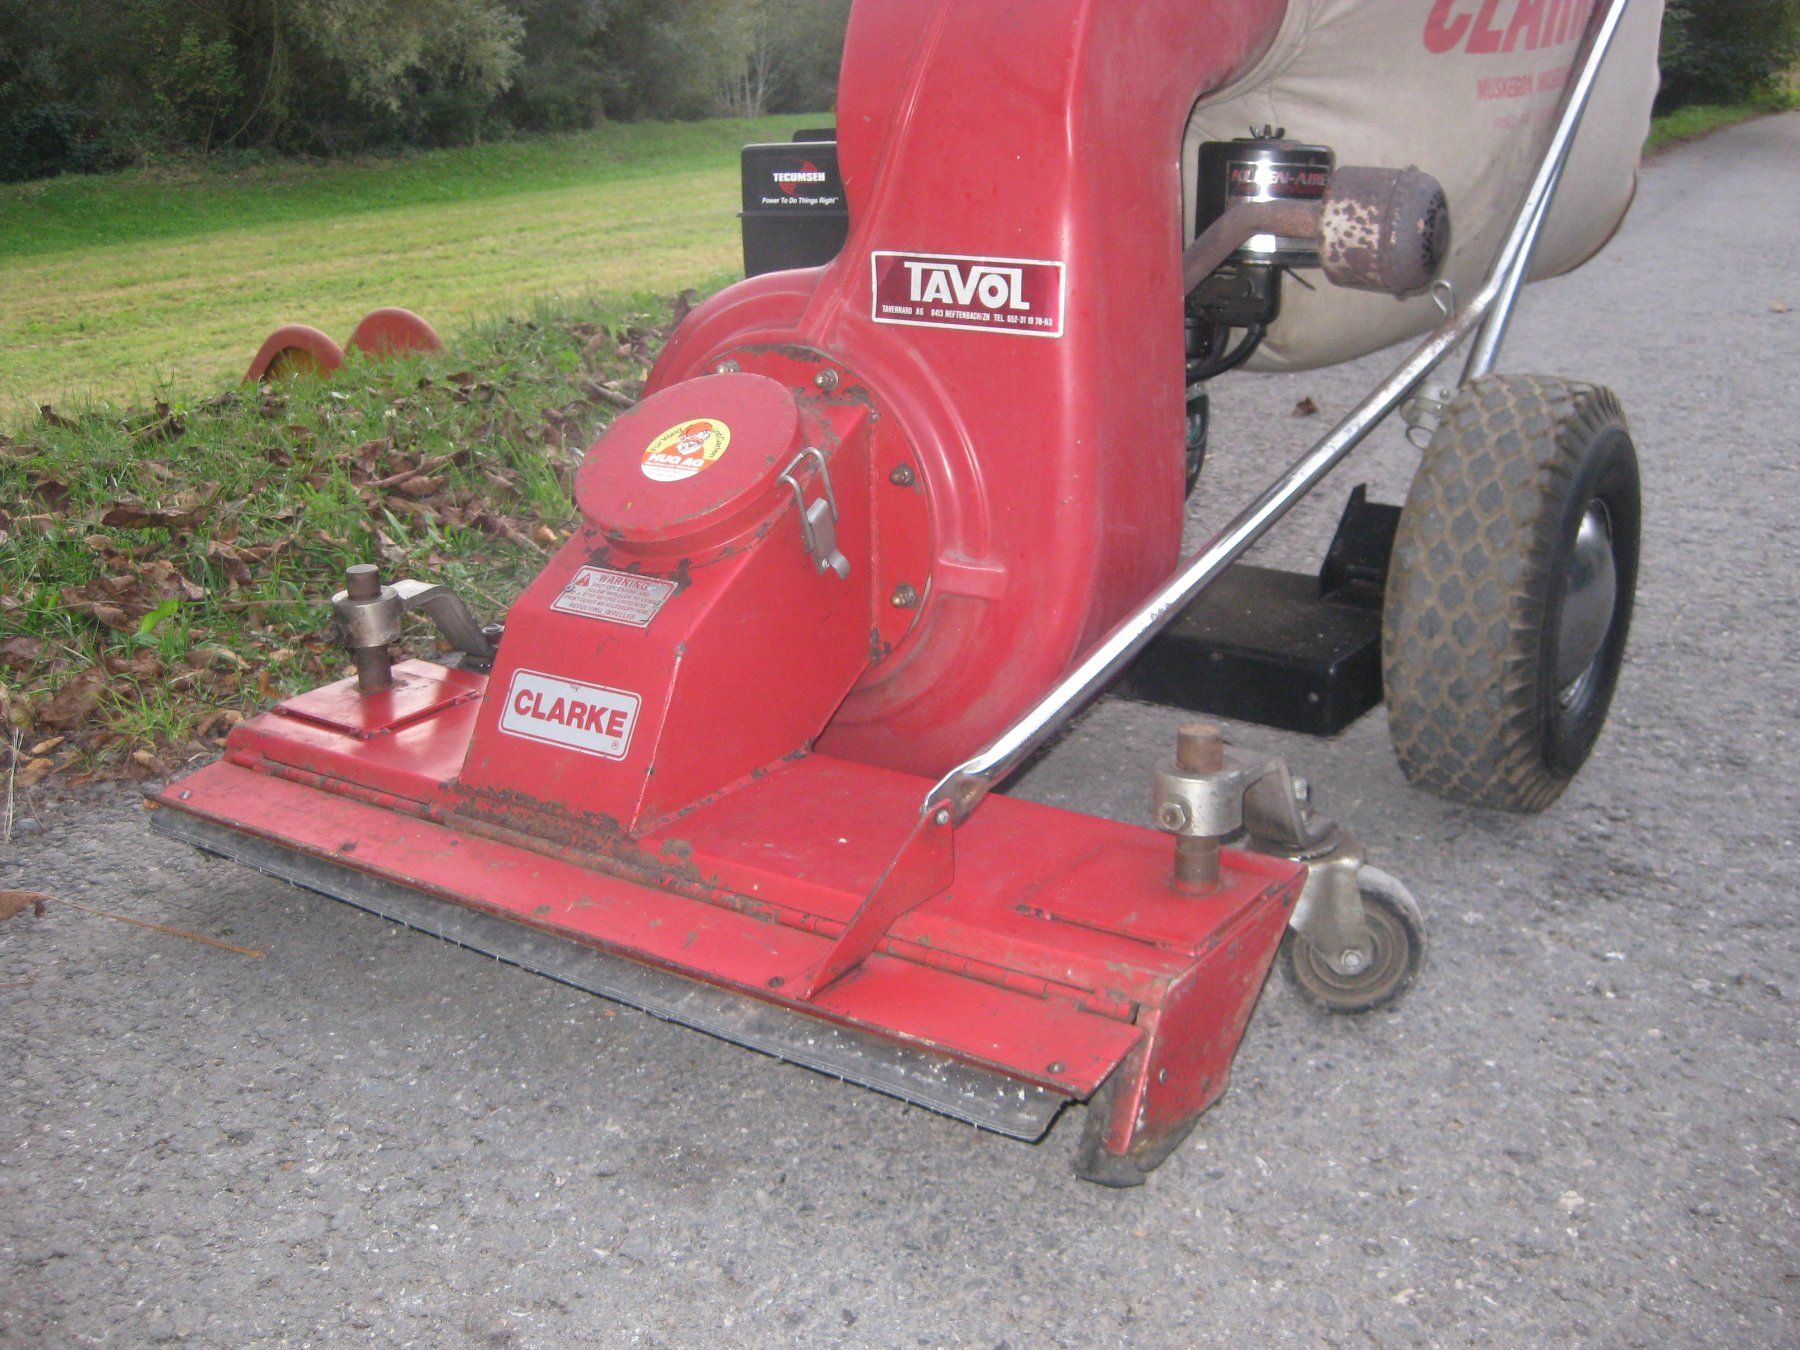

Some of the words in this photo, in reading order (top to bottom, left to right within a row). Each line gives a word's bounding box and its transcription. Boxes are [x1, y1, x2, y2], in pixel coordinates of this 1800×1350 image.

[773, 172, 825, 182] TECUMSEH
[799, 197, 818, 205] Things
[904, 261, 1030, 310] TAVOL
[915, 307, 924, 316] AG
[598, 574, 650, 590] WARNING
[568, 602, 604, 613] REVOLVING
[603, 609, 635, 619] IMPELLER
[514, 689, 628, 738] CLARKE
